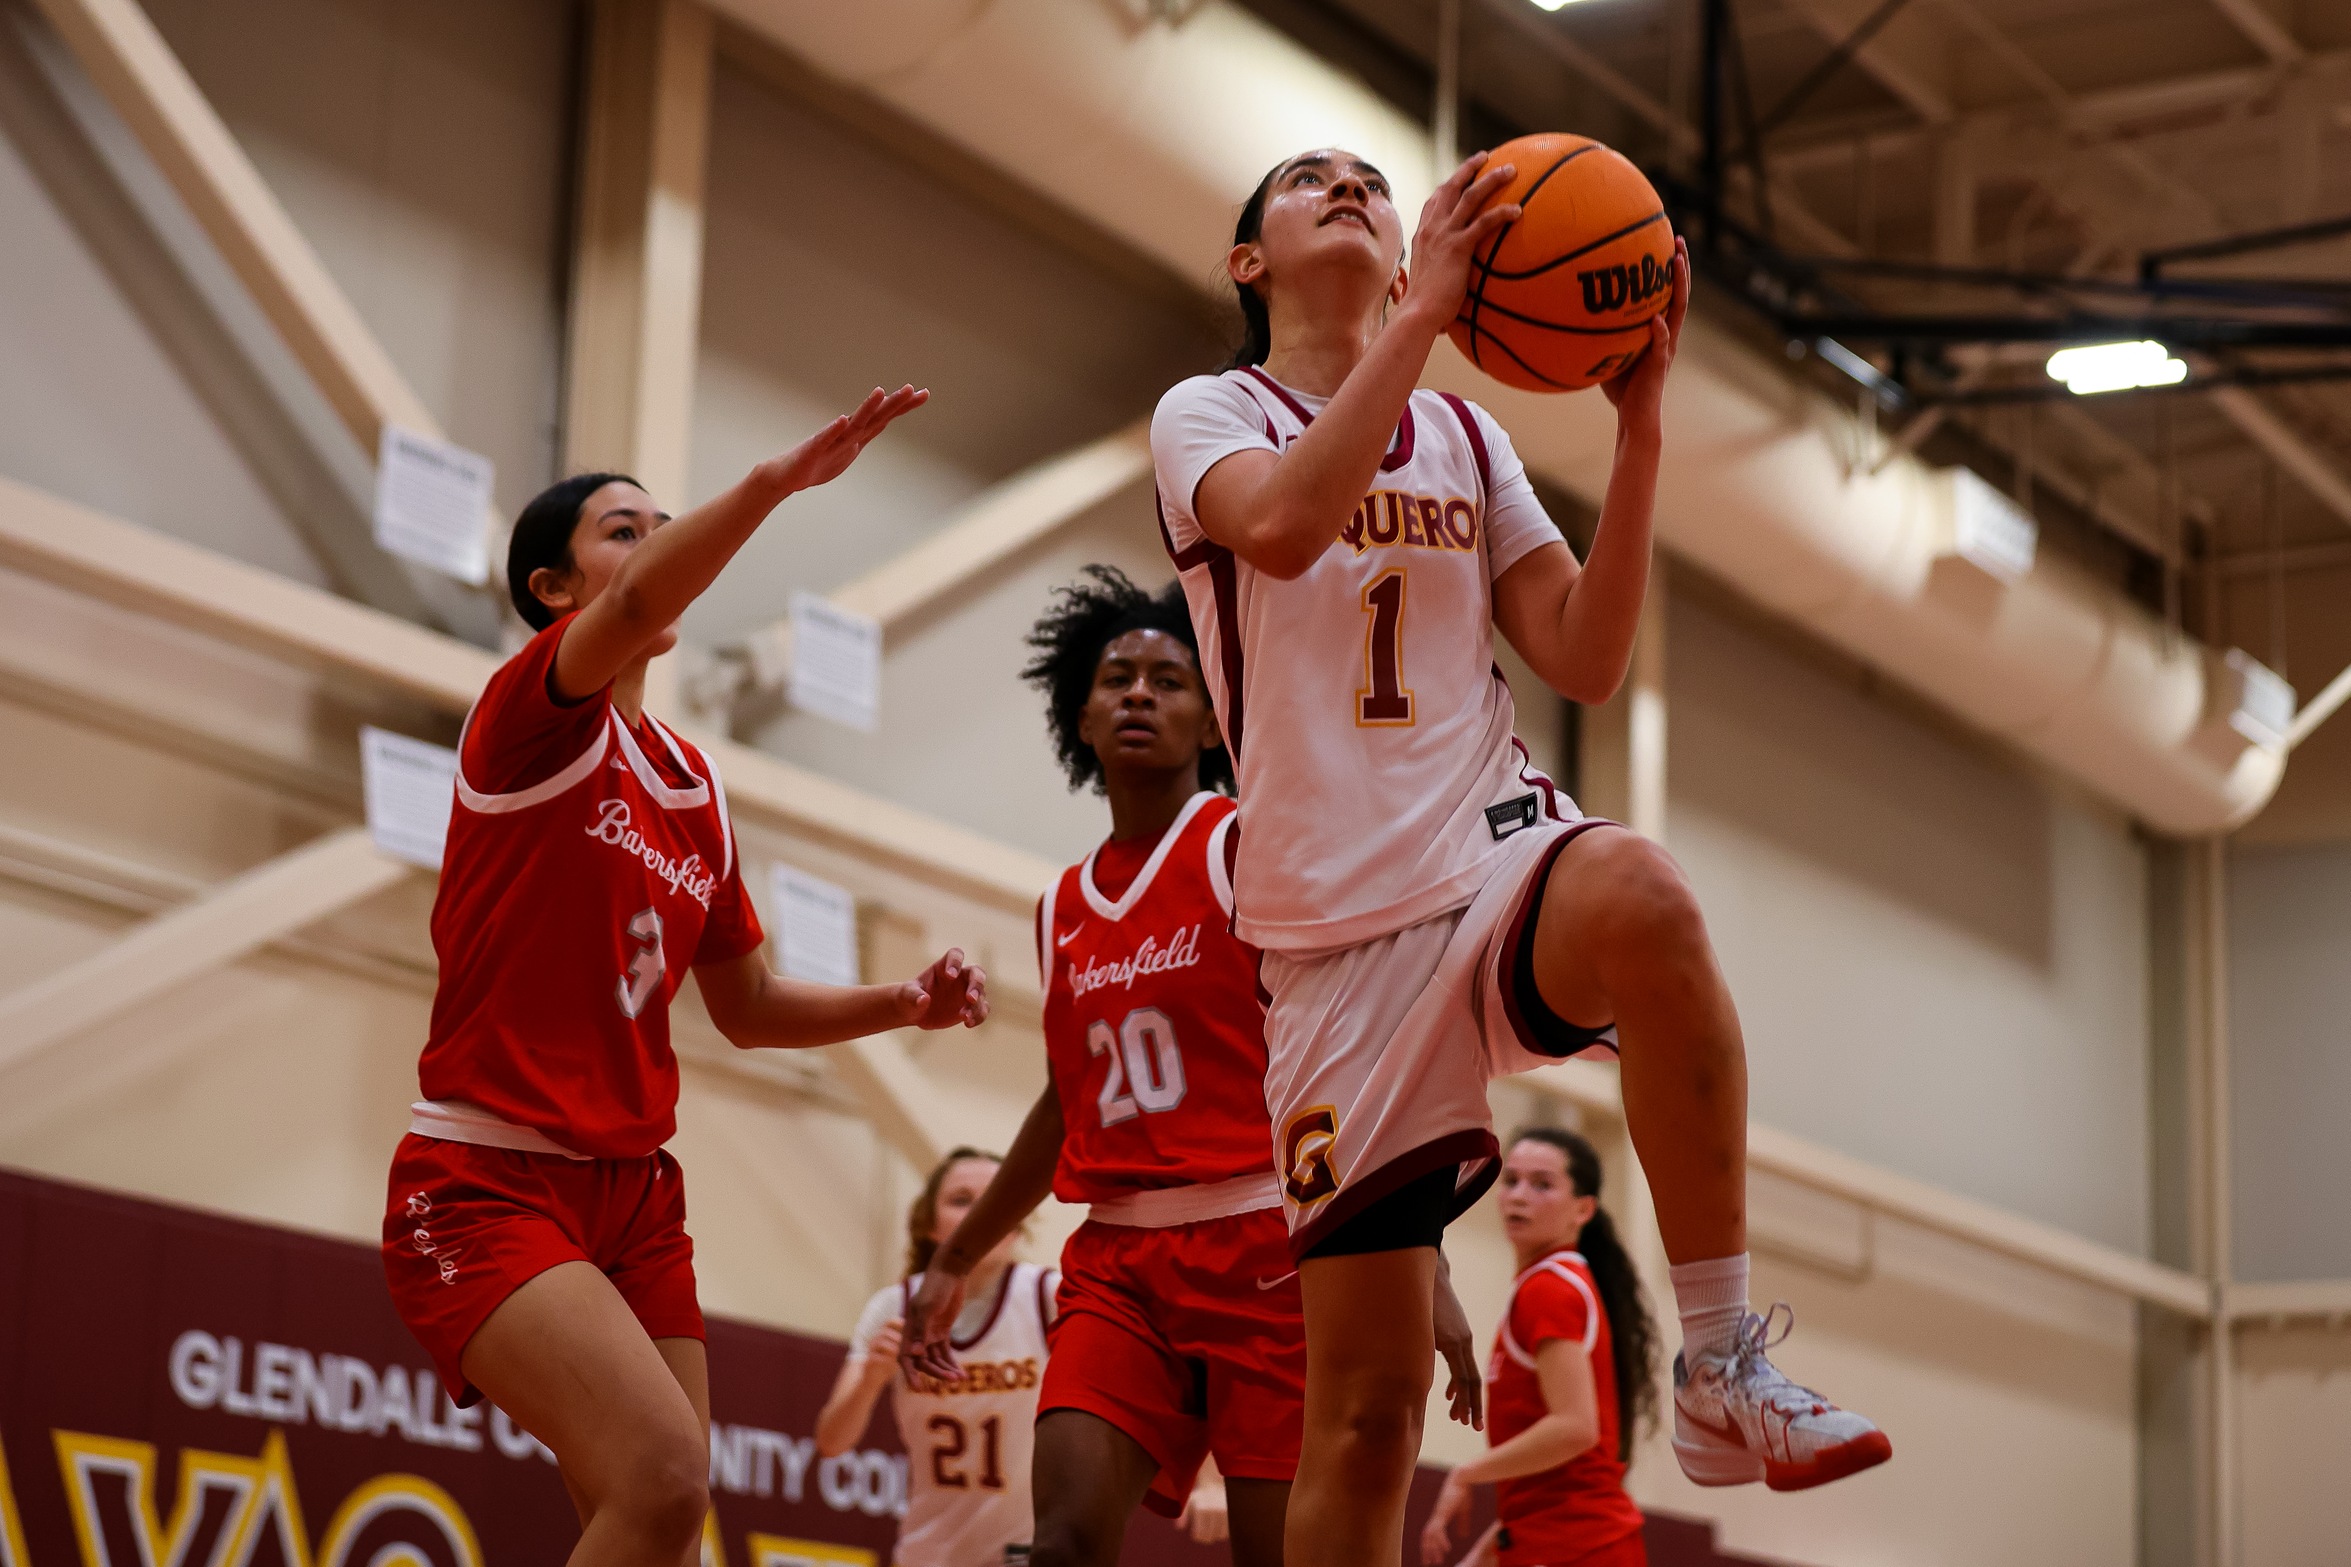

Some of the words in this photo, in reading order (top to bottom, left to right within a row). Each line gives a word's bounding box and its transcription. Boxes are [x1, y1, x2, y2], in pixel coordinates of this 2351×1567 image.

[1577, 252, 1675, 315] Wilso
[1337, 489, 1479, 557] QUERO
[1355, 566, 1415, 728] 1
[614, 905, 667, 1021] 3
[1087, 1005, 1188, 1128] 20
[1282, 1104, 1343, 1209] G
[168, 1329, 484, 1454] GLENDALE
[927, 1411, 1006, 1492] 21
